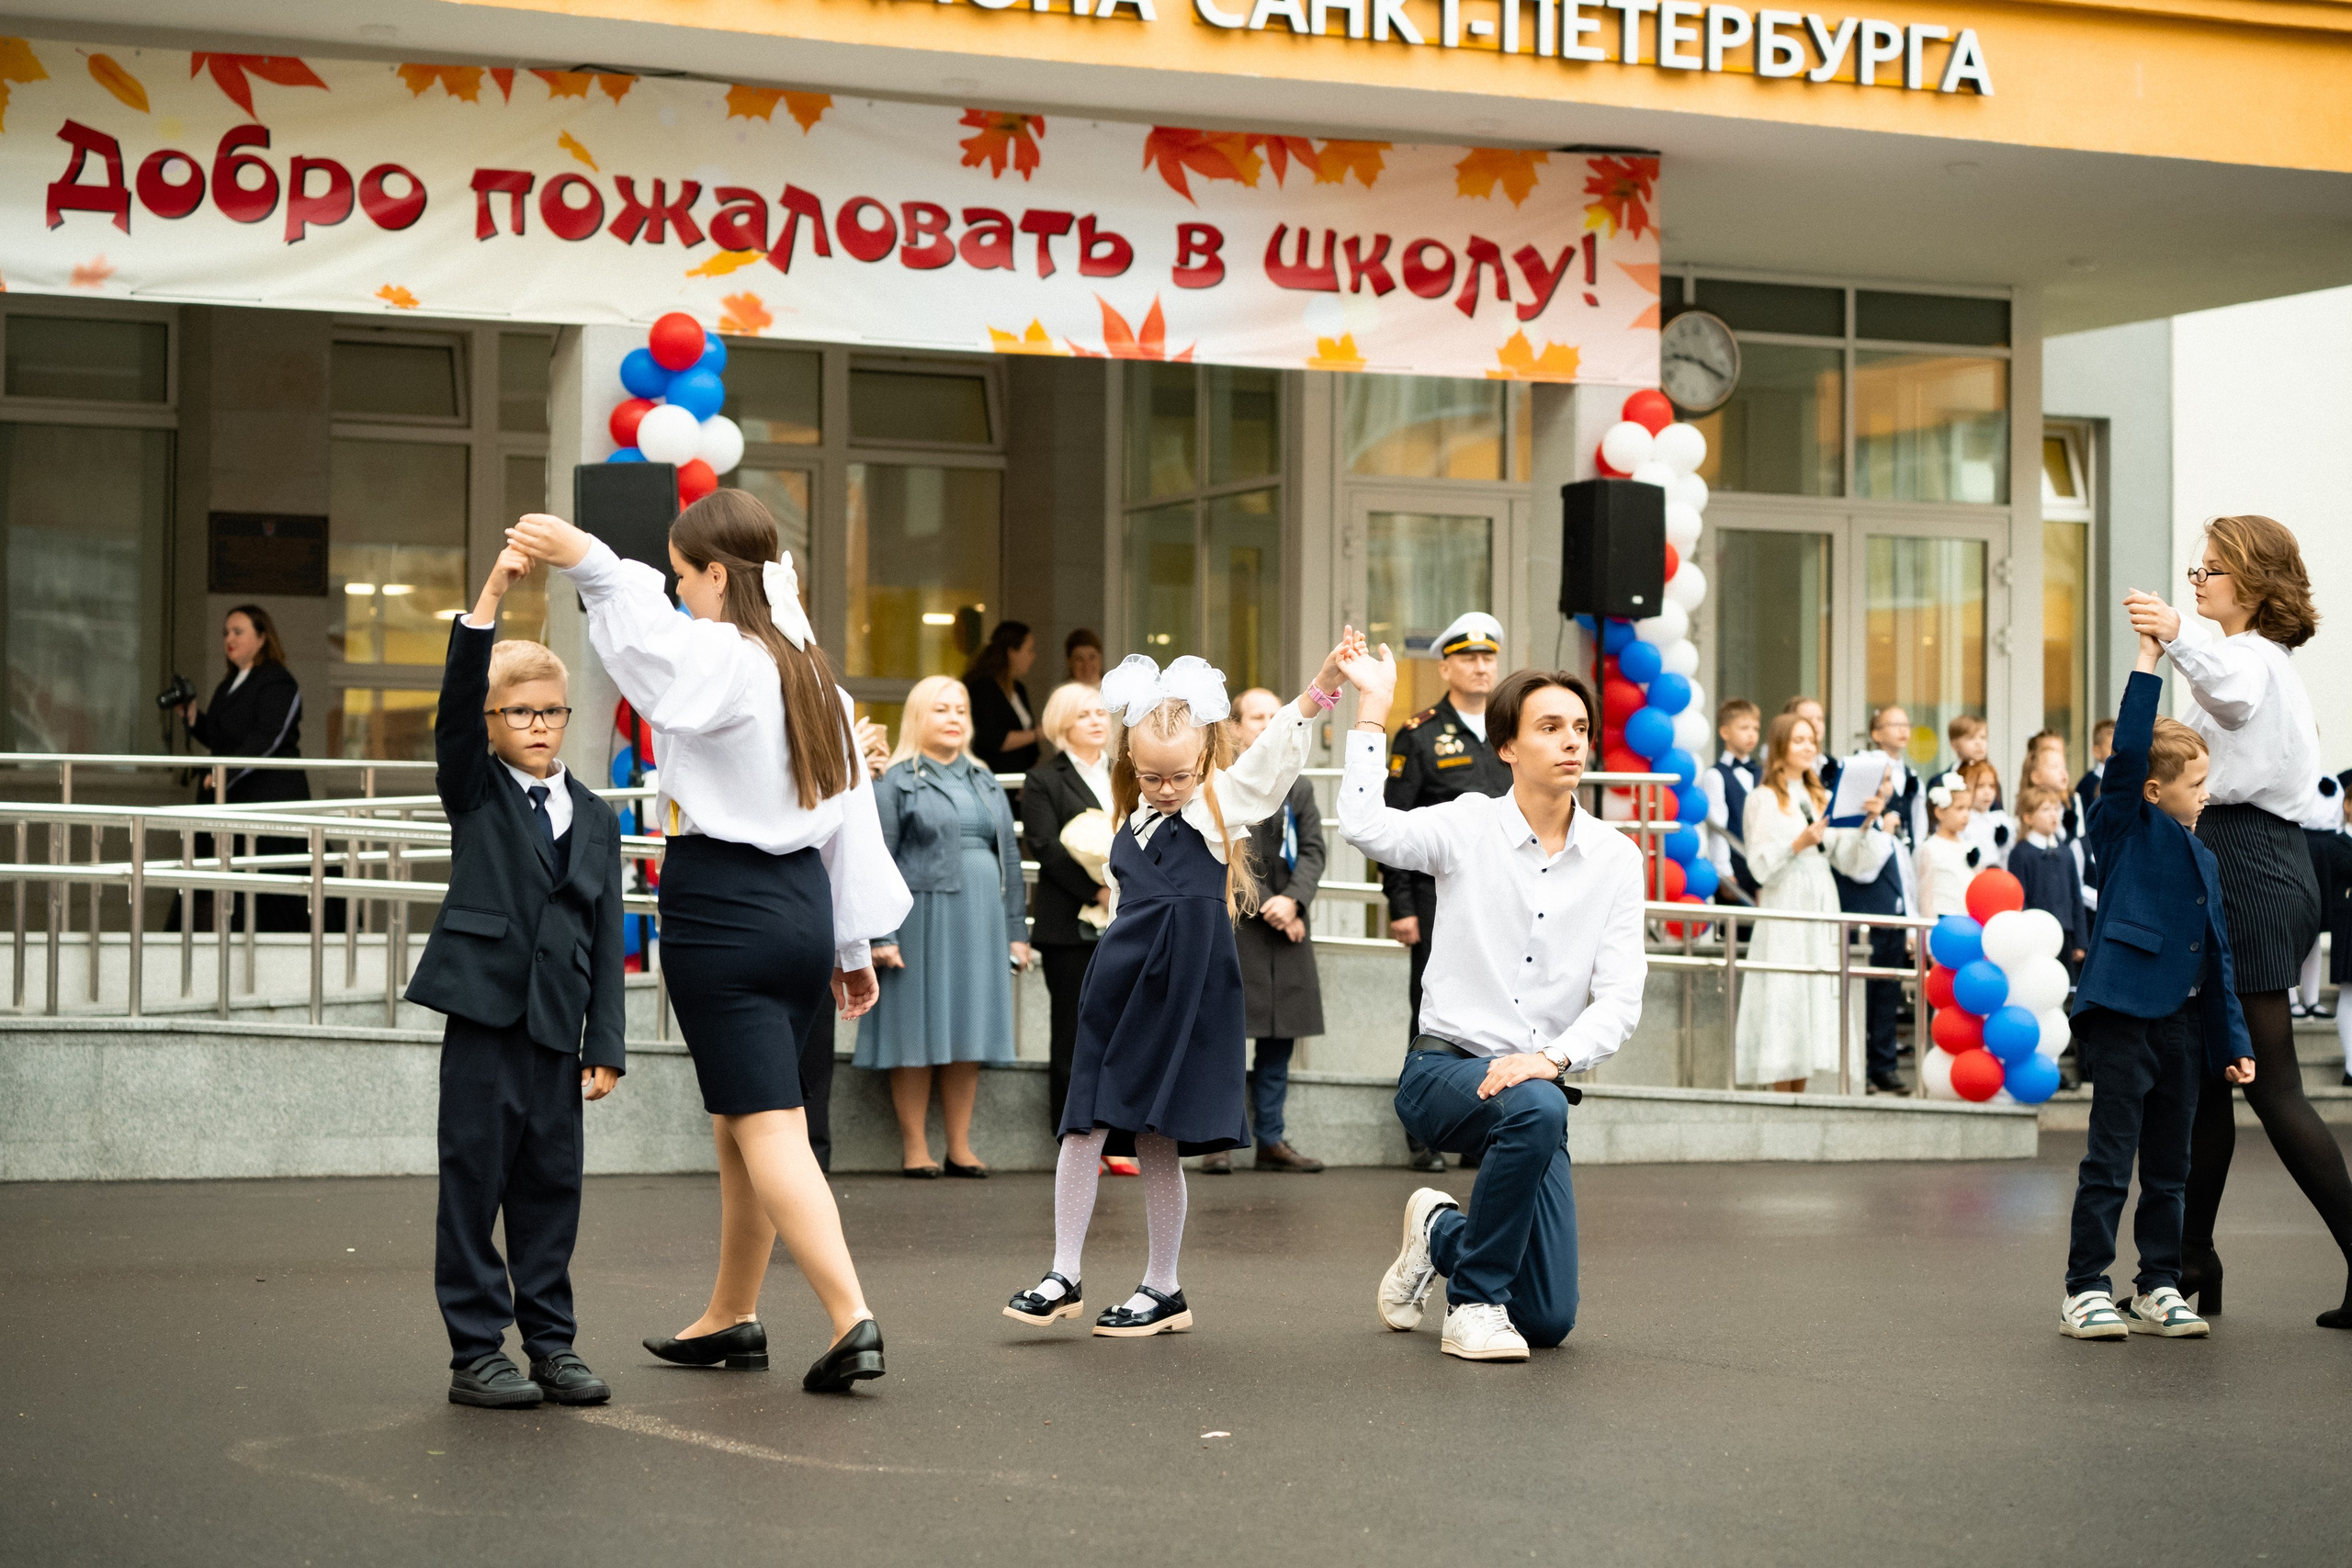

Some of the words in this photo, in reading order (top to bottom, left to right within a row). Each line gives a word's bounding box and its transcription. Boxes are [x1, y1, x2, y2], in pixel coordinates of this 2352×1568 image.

[46, 119, 428, 244] Добро
[469, 168, 1135, 279] пожаловать
[1171, 222, 1227, 289] в
[1264, 223, 1600, 321] школу!
